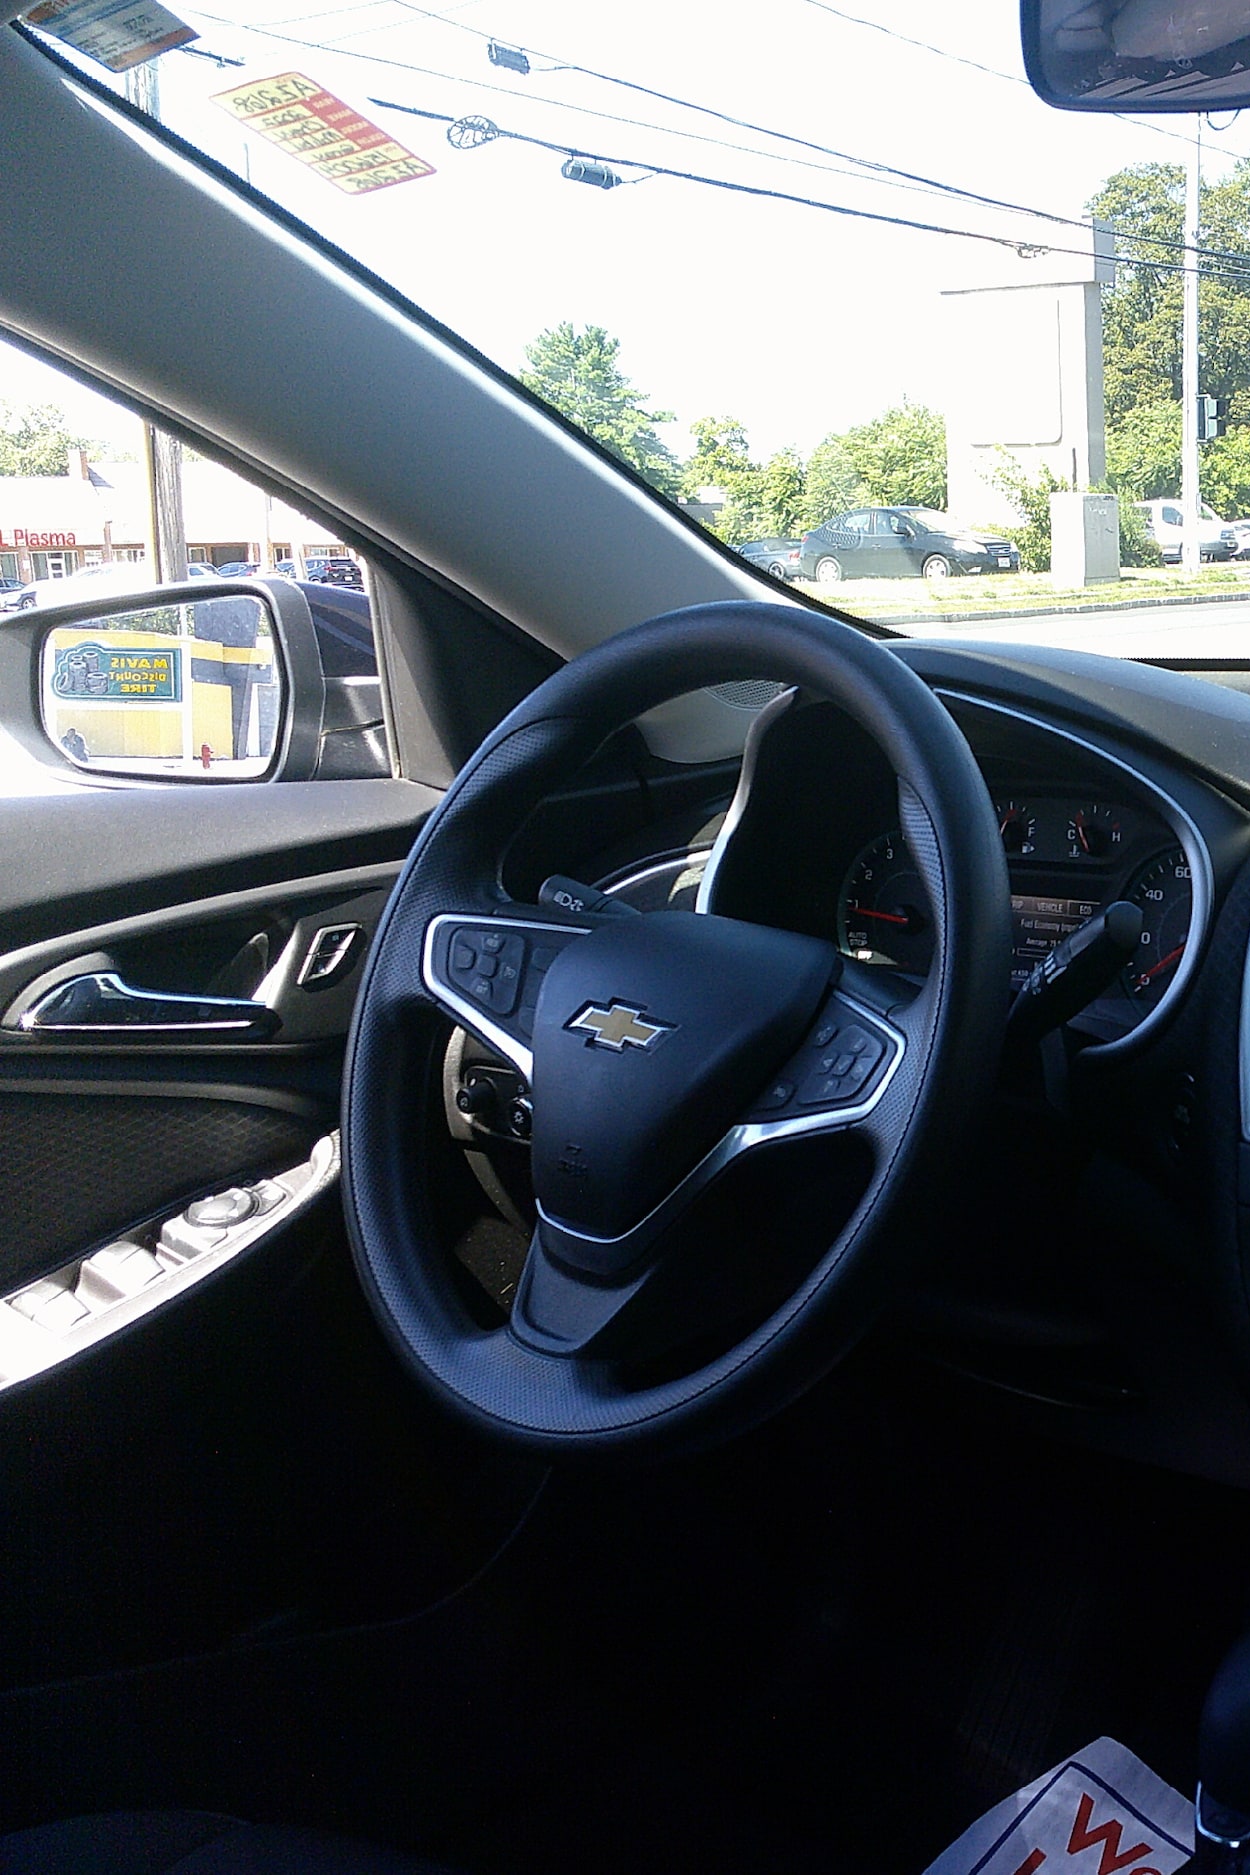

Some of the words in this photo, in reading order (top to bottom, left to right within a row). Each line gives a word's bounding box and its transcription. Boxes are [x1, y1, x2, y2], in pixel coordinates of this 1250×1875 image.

[13, 528, 77, 547] Plasma
[1028, 826, 1037, 838] F
[1067, 828, 1076, 840] C
[1112, 830, 1122, 843] H
[886, 848, 894, 860] 3
[865, 869, 873, 880] 2
[1174, 866, 1193, 879] 60
[1145, 889, 1164, 901] 40
[1036, 902, 1063, 913] VEHICLE
